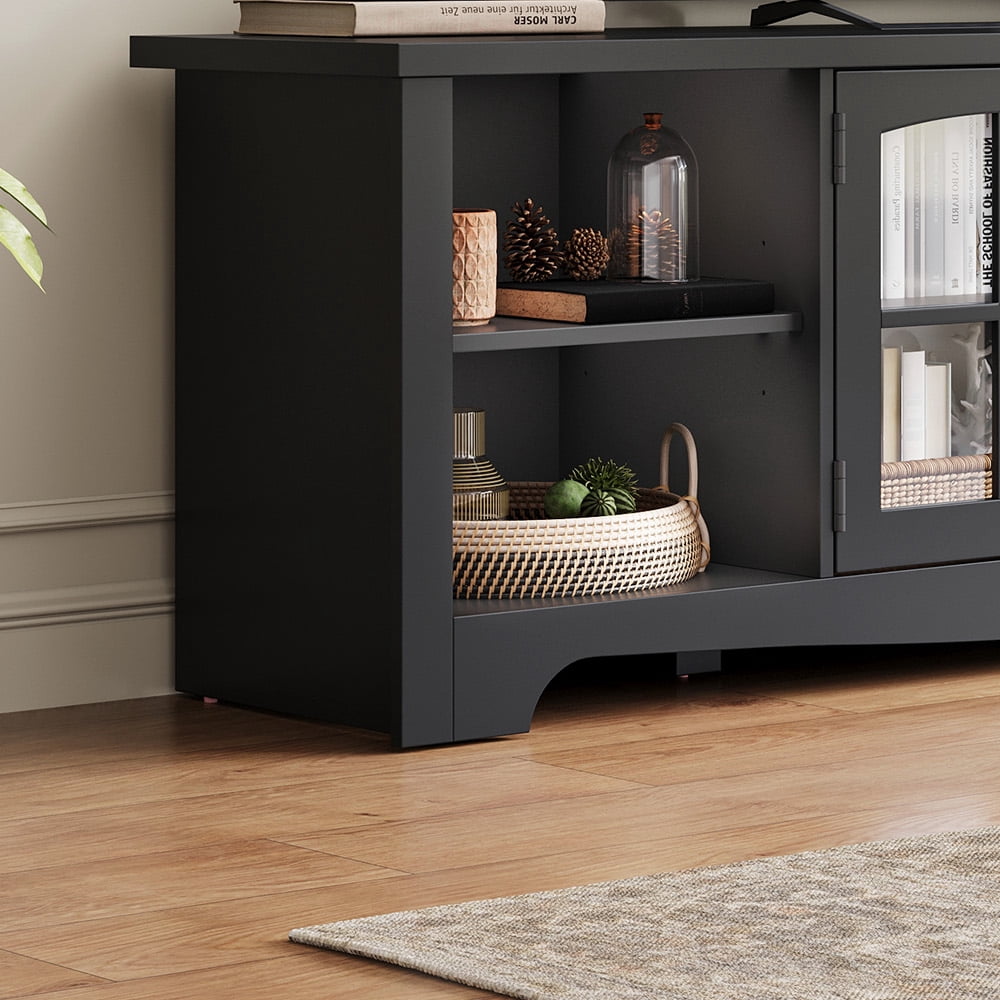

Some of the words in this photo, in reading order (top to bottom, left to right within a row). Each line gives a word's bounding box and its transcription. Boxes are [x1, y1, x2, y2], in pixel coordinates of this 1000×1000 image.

[440, 6, 459, 16] Zeit
[462, 7, 484, 15] neue
[487, 6, 507, 15] eine
[509, 5, 523, 15] für
[526, 5, 577, 15] Architektur
[513, 15, 548, 25] MOSER
[552, 15, 577, 25] CARL
